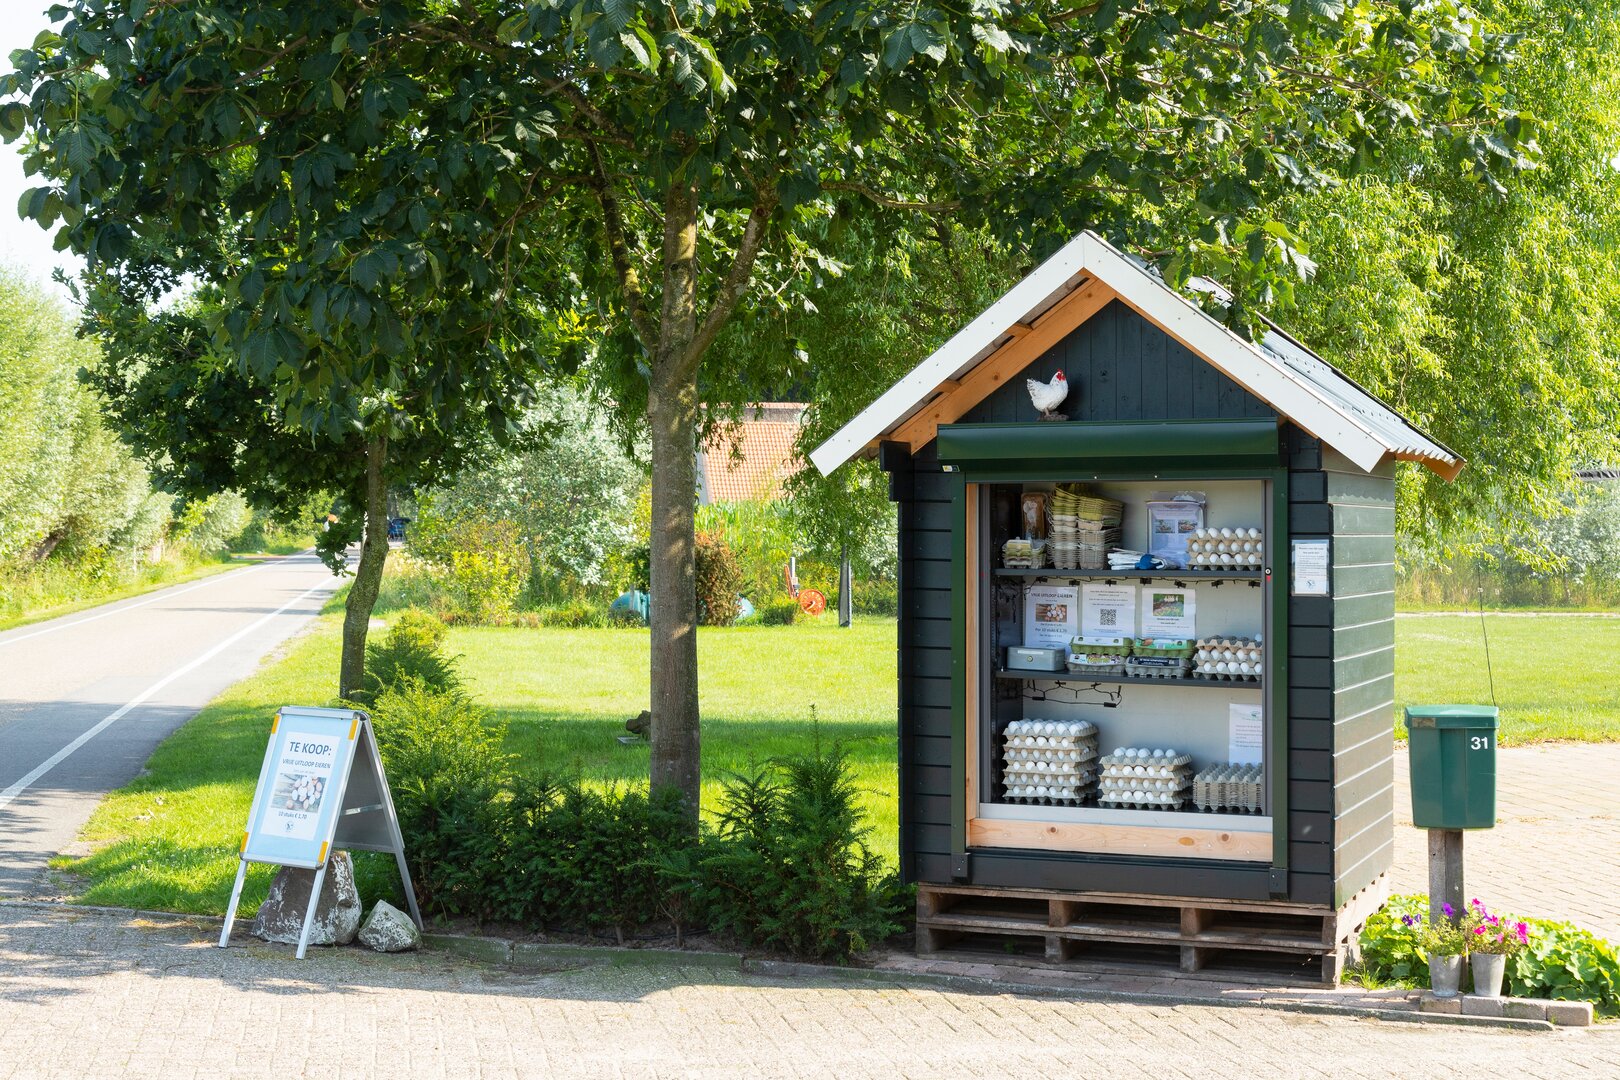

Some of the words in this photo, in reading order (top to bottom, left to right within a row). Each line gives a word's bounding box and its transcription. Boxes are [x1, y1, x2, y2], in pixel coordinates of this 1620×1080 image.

[290, 741, 301, 753] TE
[302, 742, 332, 756] KOOP:
[1470, 736, 1489, 750] 31
